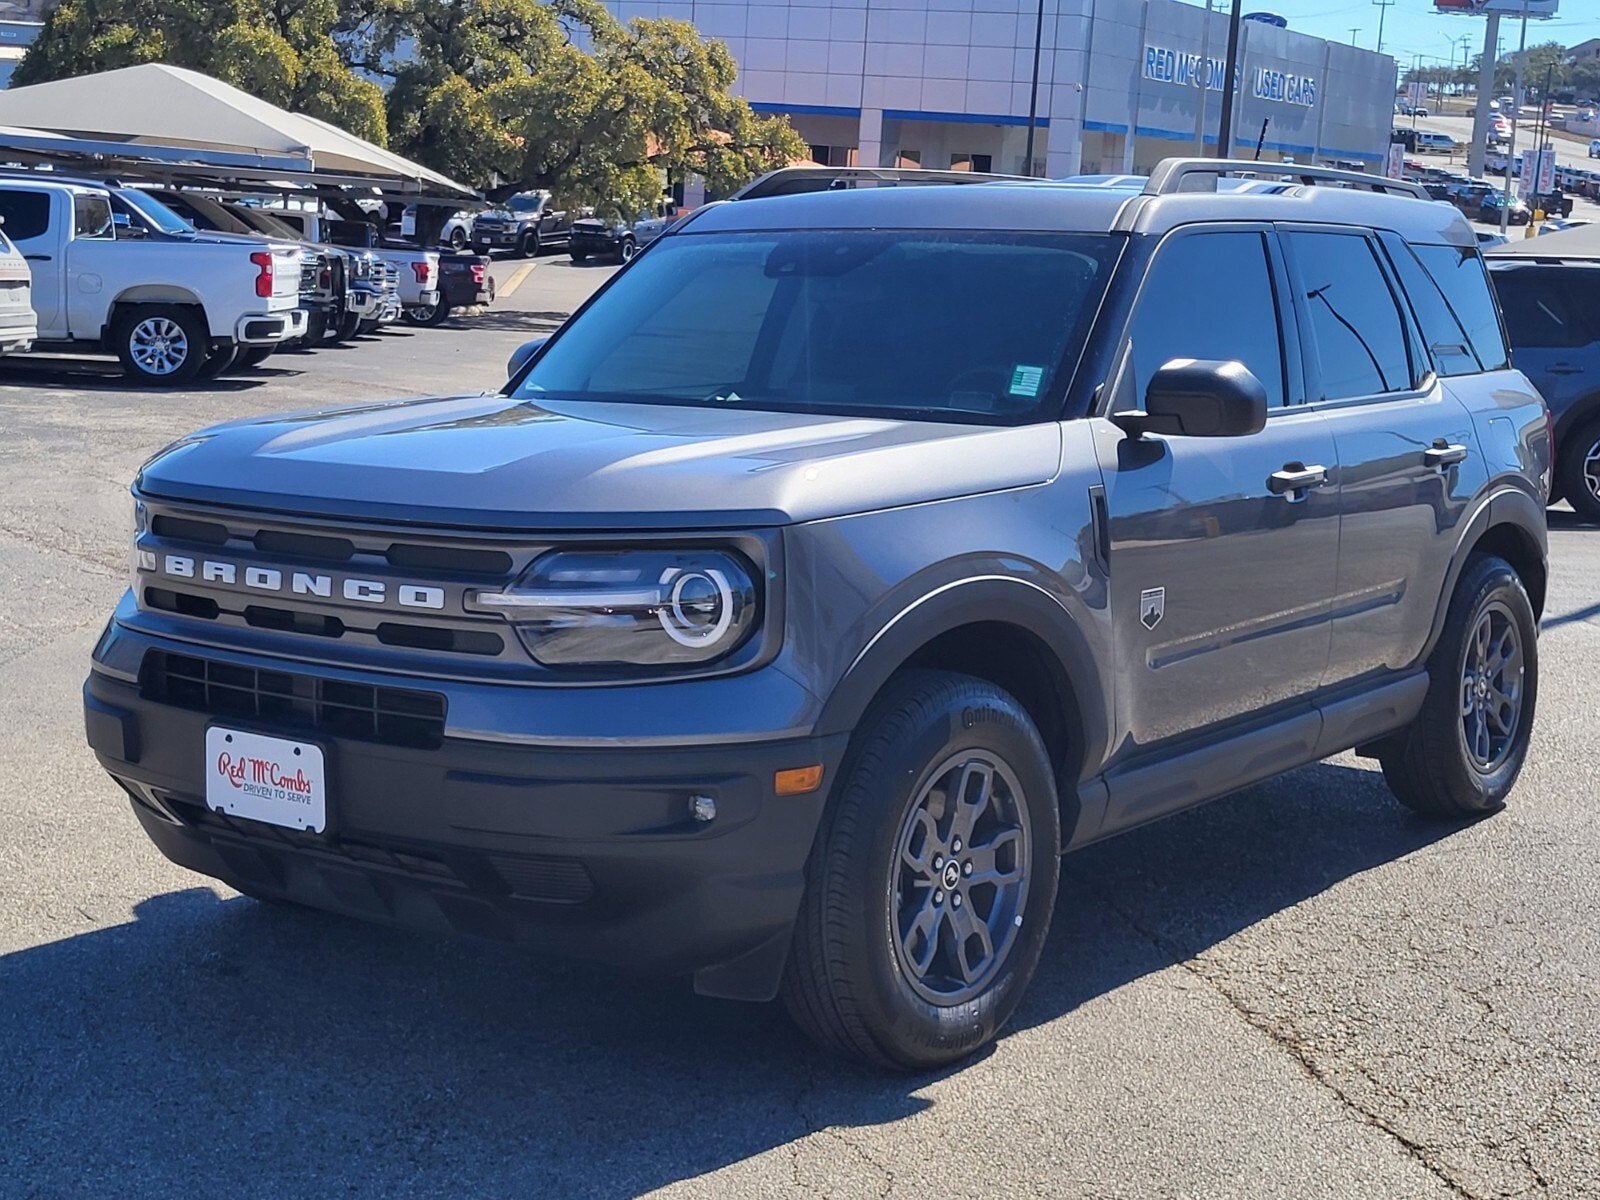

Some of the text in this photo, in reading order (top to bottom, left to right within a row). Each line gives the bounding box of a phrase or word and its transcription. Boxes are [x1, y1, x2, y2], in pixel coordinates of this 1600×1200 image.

[1145, 47, 1175, 81] RED
[1255, 68, 1315, 106] USED CARS
[164, 554, 446, 610] BRONCO
[218, 751, 247, 789] Red
[243, 783, 312, 805] DRIVEN TO SERVE
